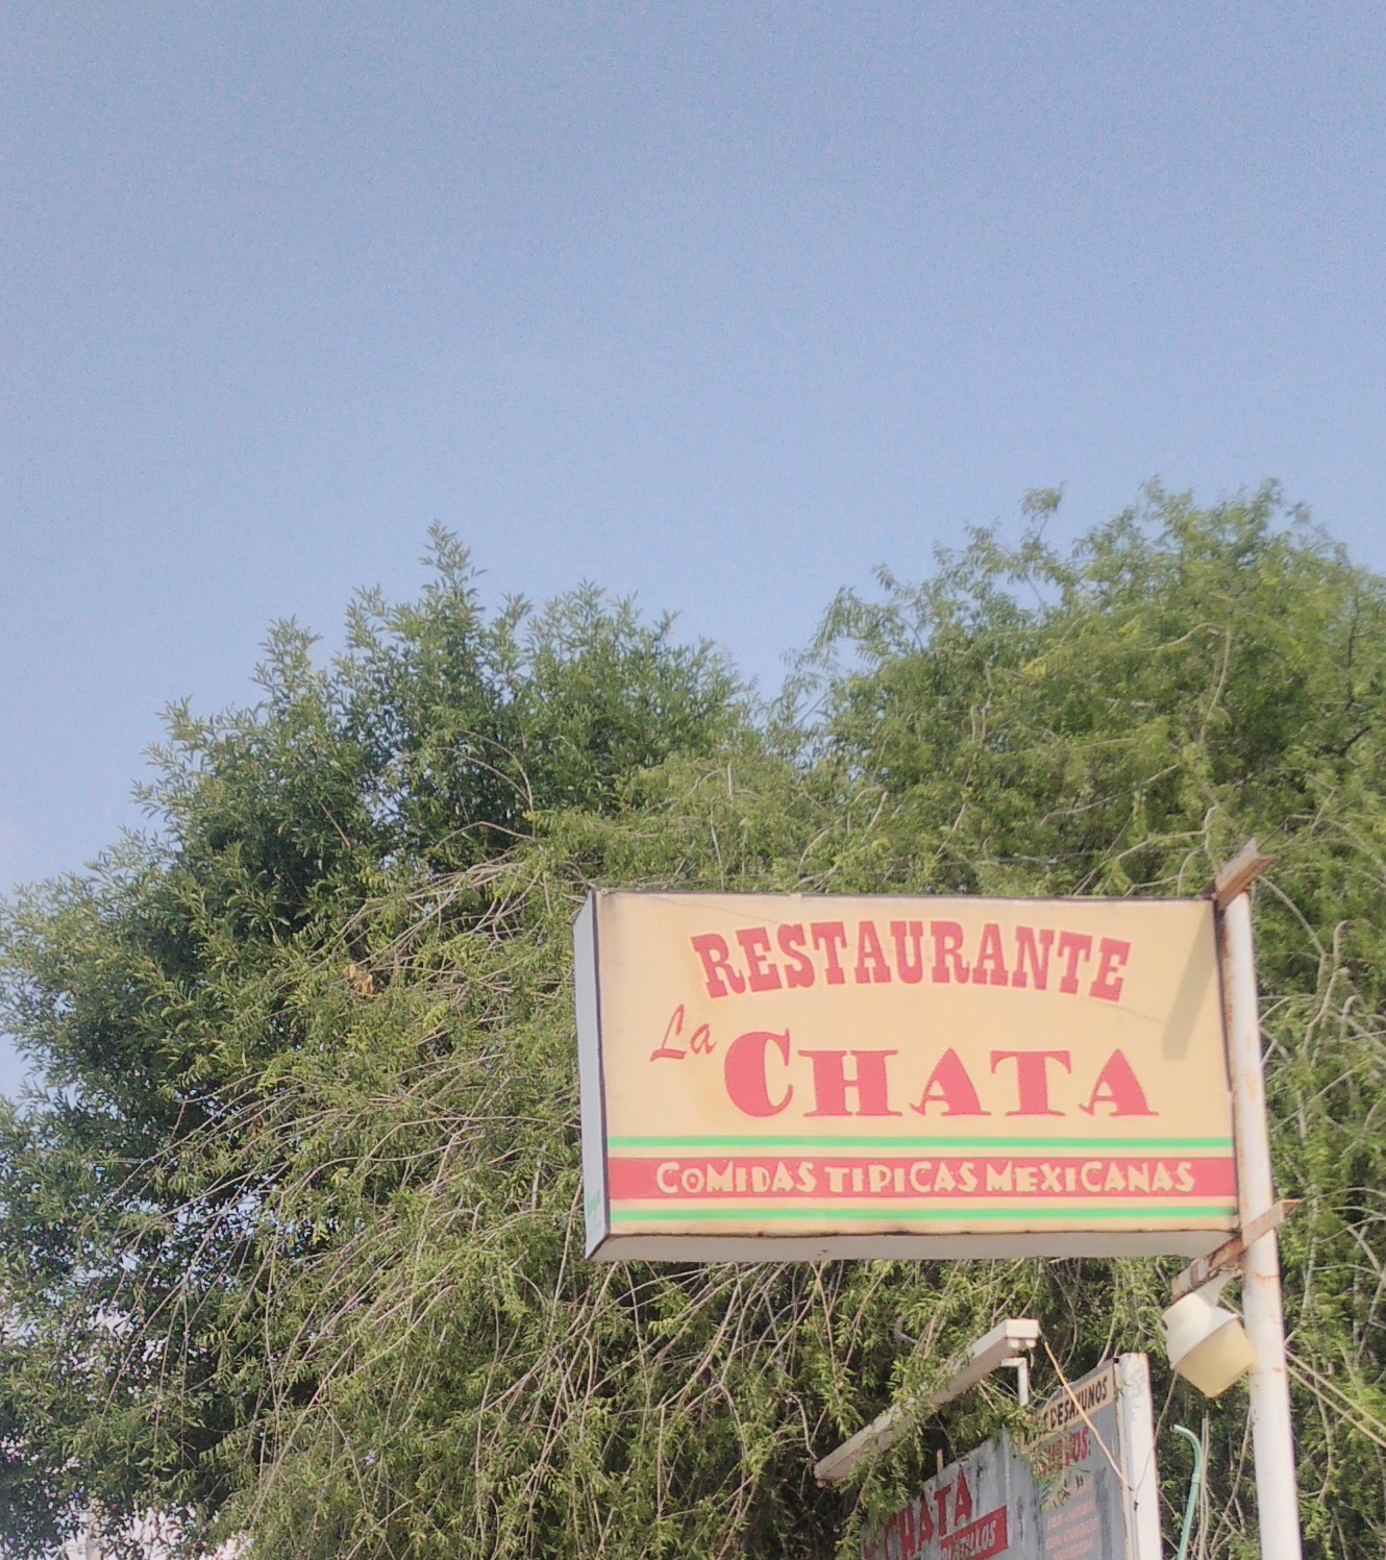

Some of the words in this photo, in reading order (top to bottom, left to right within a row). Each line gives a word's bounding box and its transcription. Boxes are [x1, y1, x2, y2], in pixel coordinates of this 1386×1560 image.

[691, 920, 1131, 1001] RESTAURANTE
[650, 1004, 716, 1061] La
[724, 1029, 1159, 1118] CHATA
[656, 1160, 816, 1194] COMIDAS
[824, 1161, 977, 1194] TIPICAS
[985, 1160, 1194, 1194] MEXICANAS
